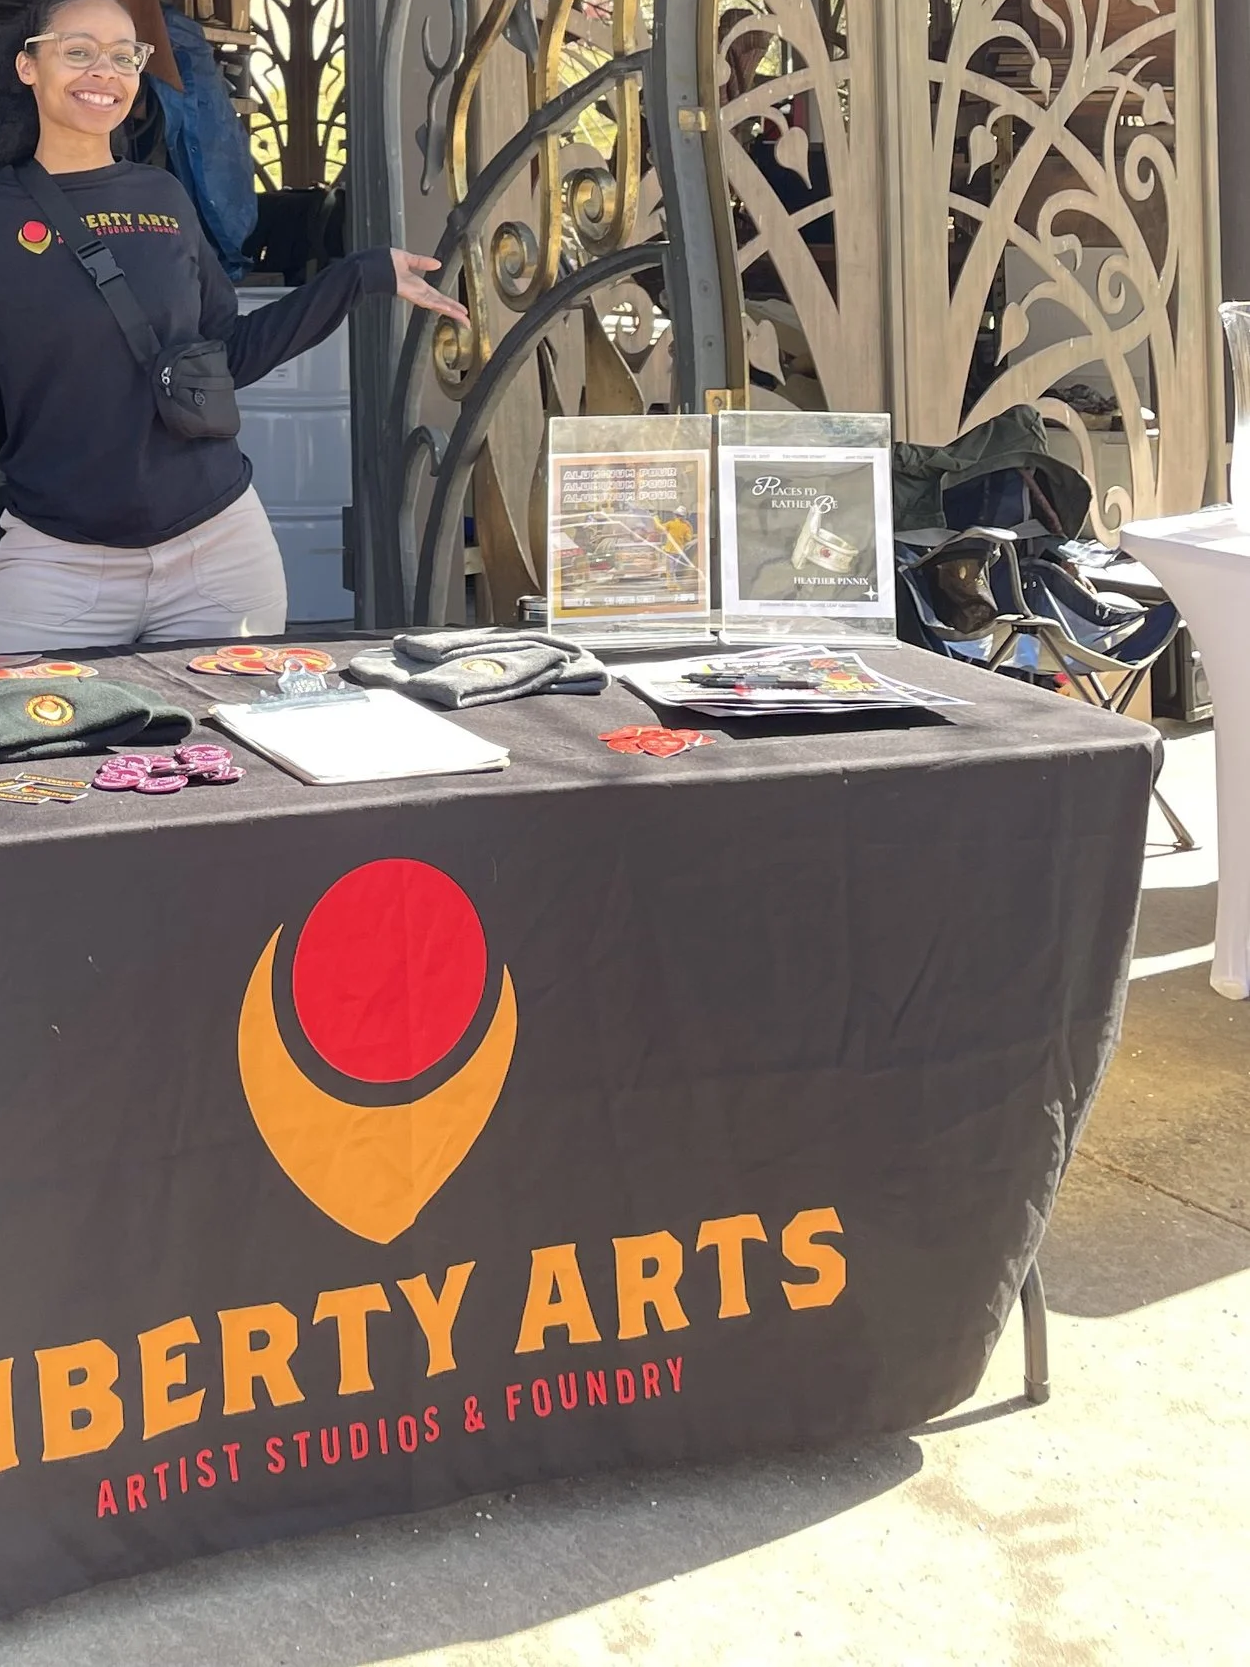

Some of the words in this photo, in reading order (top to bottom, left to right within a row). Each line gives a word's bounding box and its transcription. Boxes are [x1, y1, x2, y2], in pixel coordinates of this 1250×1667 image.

[563, 469, 635, 481] ALUMINUM
[639, 467, 677, 477] POUR
[639, 479, 677, 488] POUR
[752, 476, 802, 496] PLACES
[639, 491, 677, 501] POUR
[771, 500, 812, 509] RATHER
[813, 495, 838, 514] BE
[793, 576, 835, 585] HEATHER
[837, 577, 869, 586] PINNIX
[515, 1206, 848, 1355] ARTS
[96, 1442, 241, 1518] ARTIST
[265, 1406, 441, 1474] STUDIOS
[464, 1395, 486, 1433] &
[505, 1356, 685, 1422] FOUNDRY
